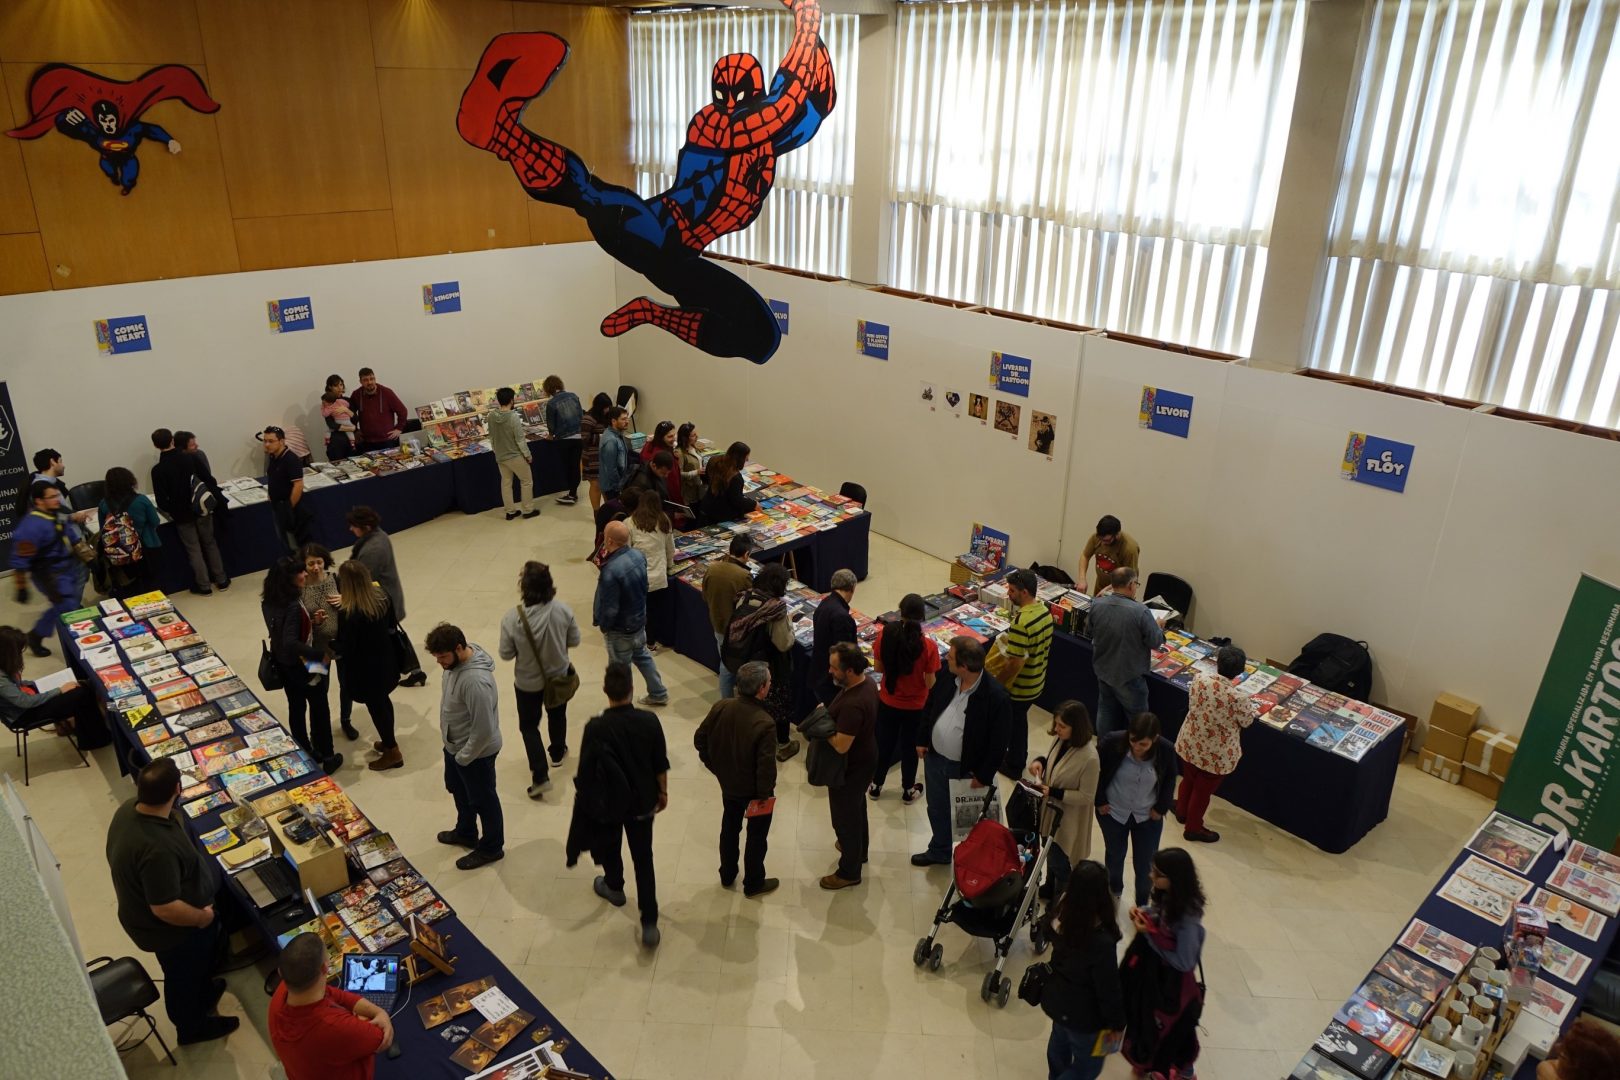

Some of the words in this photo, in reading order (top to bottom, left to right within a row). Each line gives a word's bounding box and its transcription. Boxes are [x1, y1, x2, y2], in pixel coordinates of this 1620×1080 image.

[434, 292, 460, 302] KINGPIN
[284, 304, 309, 315] COMIC
[285, 311, 310, 323] HEART
[114, 323, 144, 335] COMIC
[116, 330, 145, 343] HEART
[1002, 363, 1029, 372] LIVRARIA
[1002, 376, 1029, 386] KARTOON
[1156, 405, 1190, 418] LEVOIR
[1381, 451, 1392, 462] G
[1366, 459, 1404, 475] FLOY
[1554, 735, 1570, 766] LIVRARIA
[1566, 683, 1591, 734] ESPECIALIZADA
[1590, 646, 1606, 671] BANDA
[1600, 603, 1620, 647] DESENHADA
